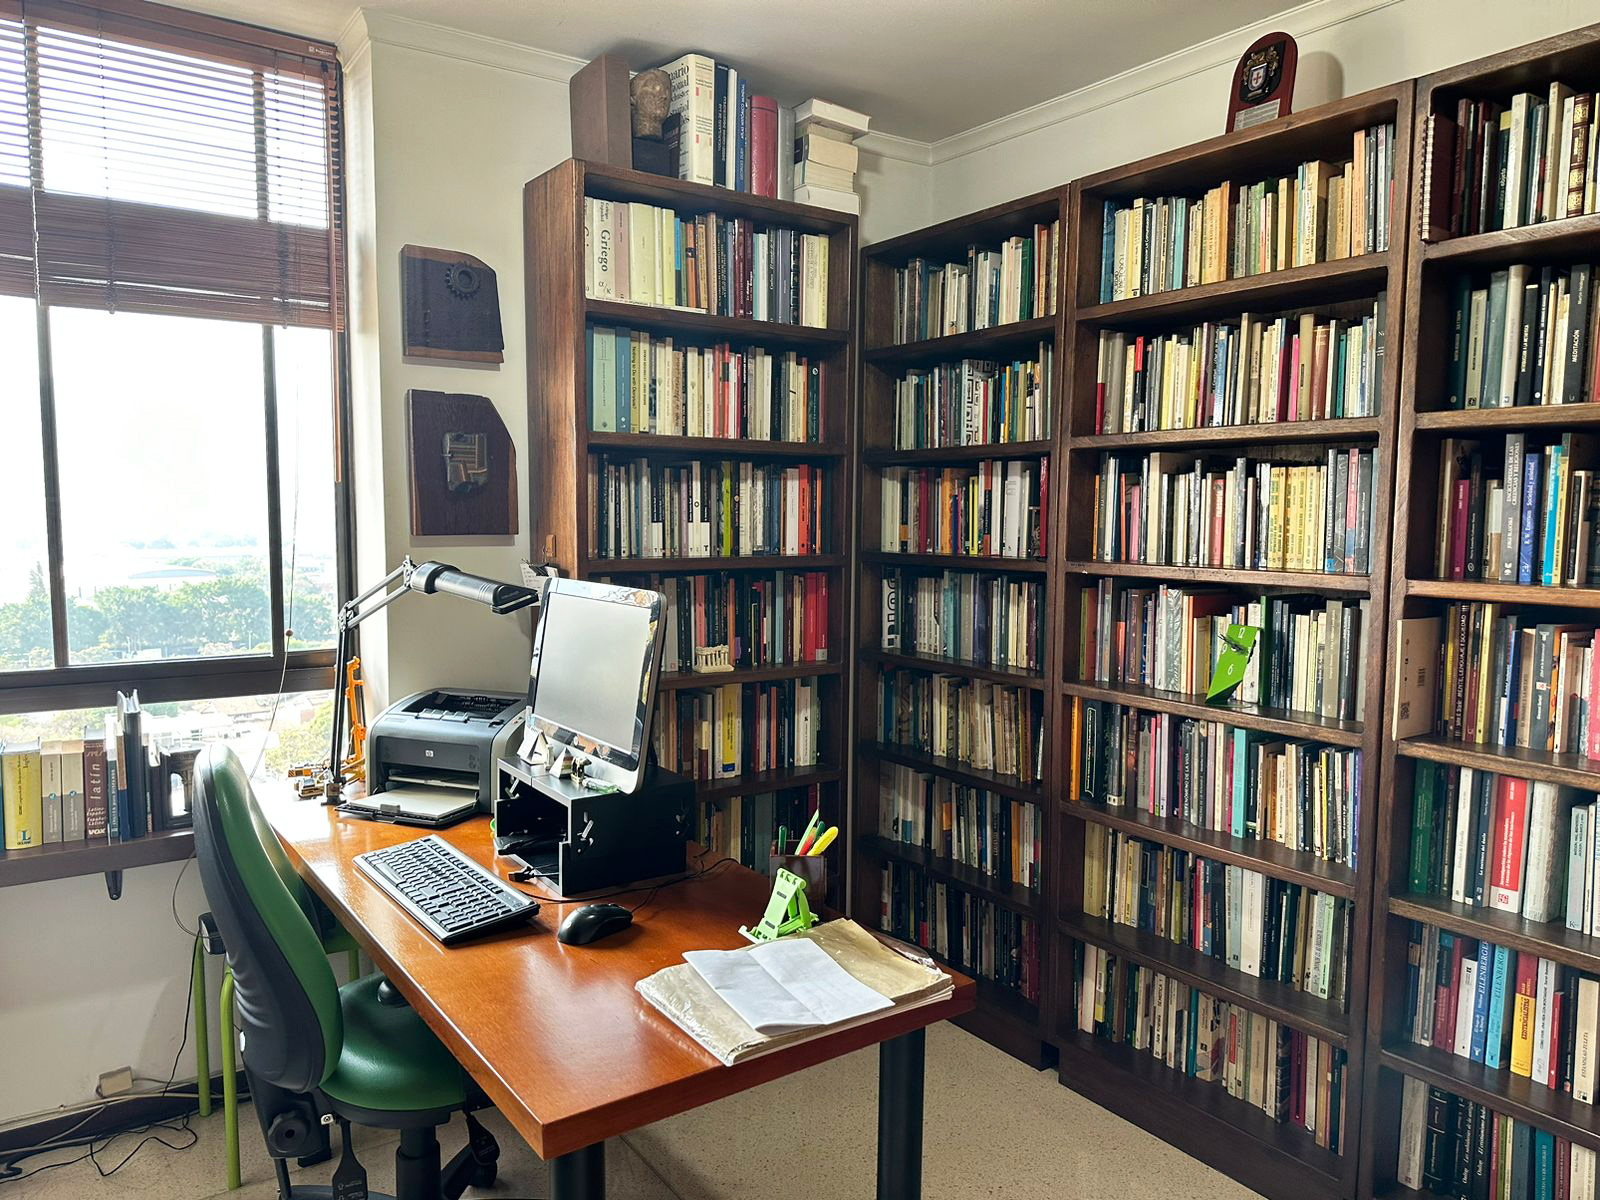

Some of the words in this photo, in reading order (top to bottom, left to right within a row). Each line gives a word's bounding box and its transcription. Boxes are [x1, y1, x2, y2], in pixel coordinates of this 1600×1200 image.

[598, 229, 611, 272] Griego
[1571, 329, 1580, 362] MEDITACIÓN
[1227, 664, 1234, 676] 6
[89, 763, 102, 800] latín
[1494, 943, 1506, 998] EILENBERGE
